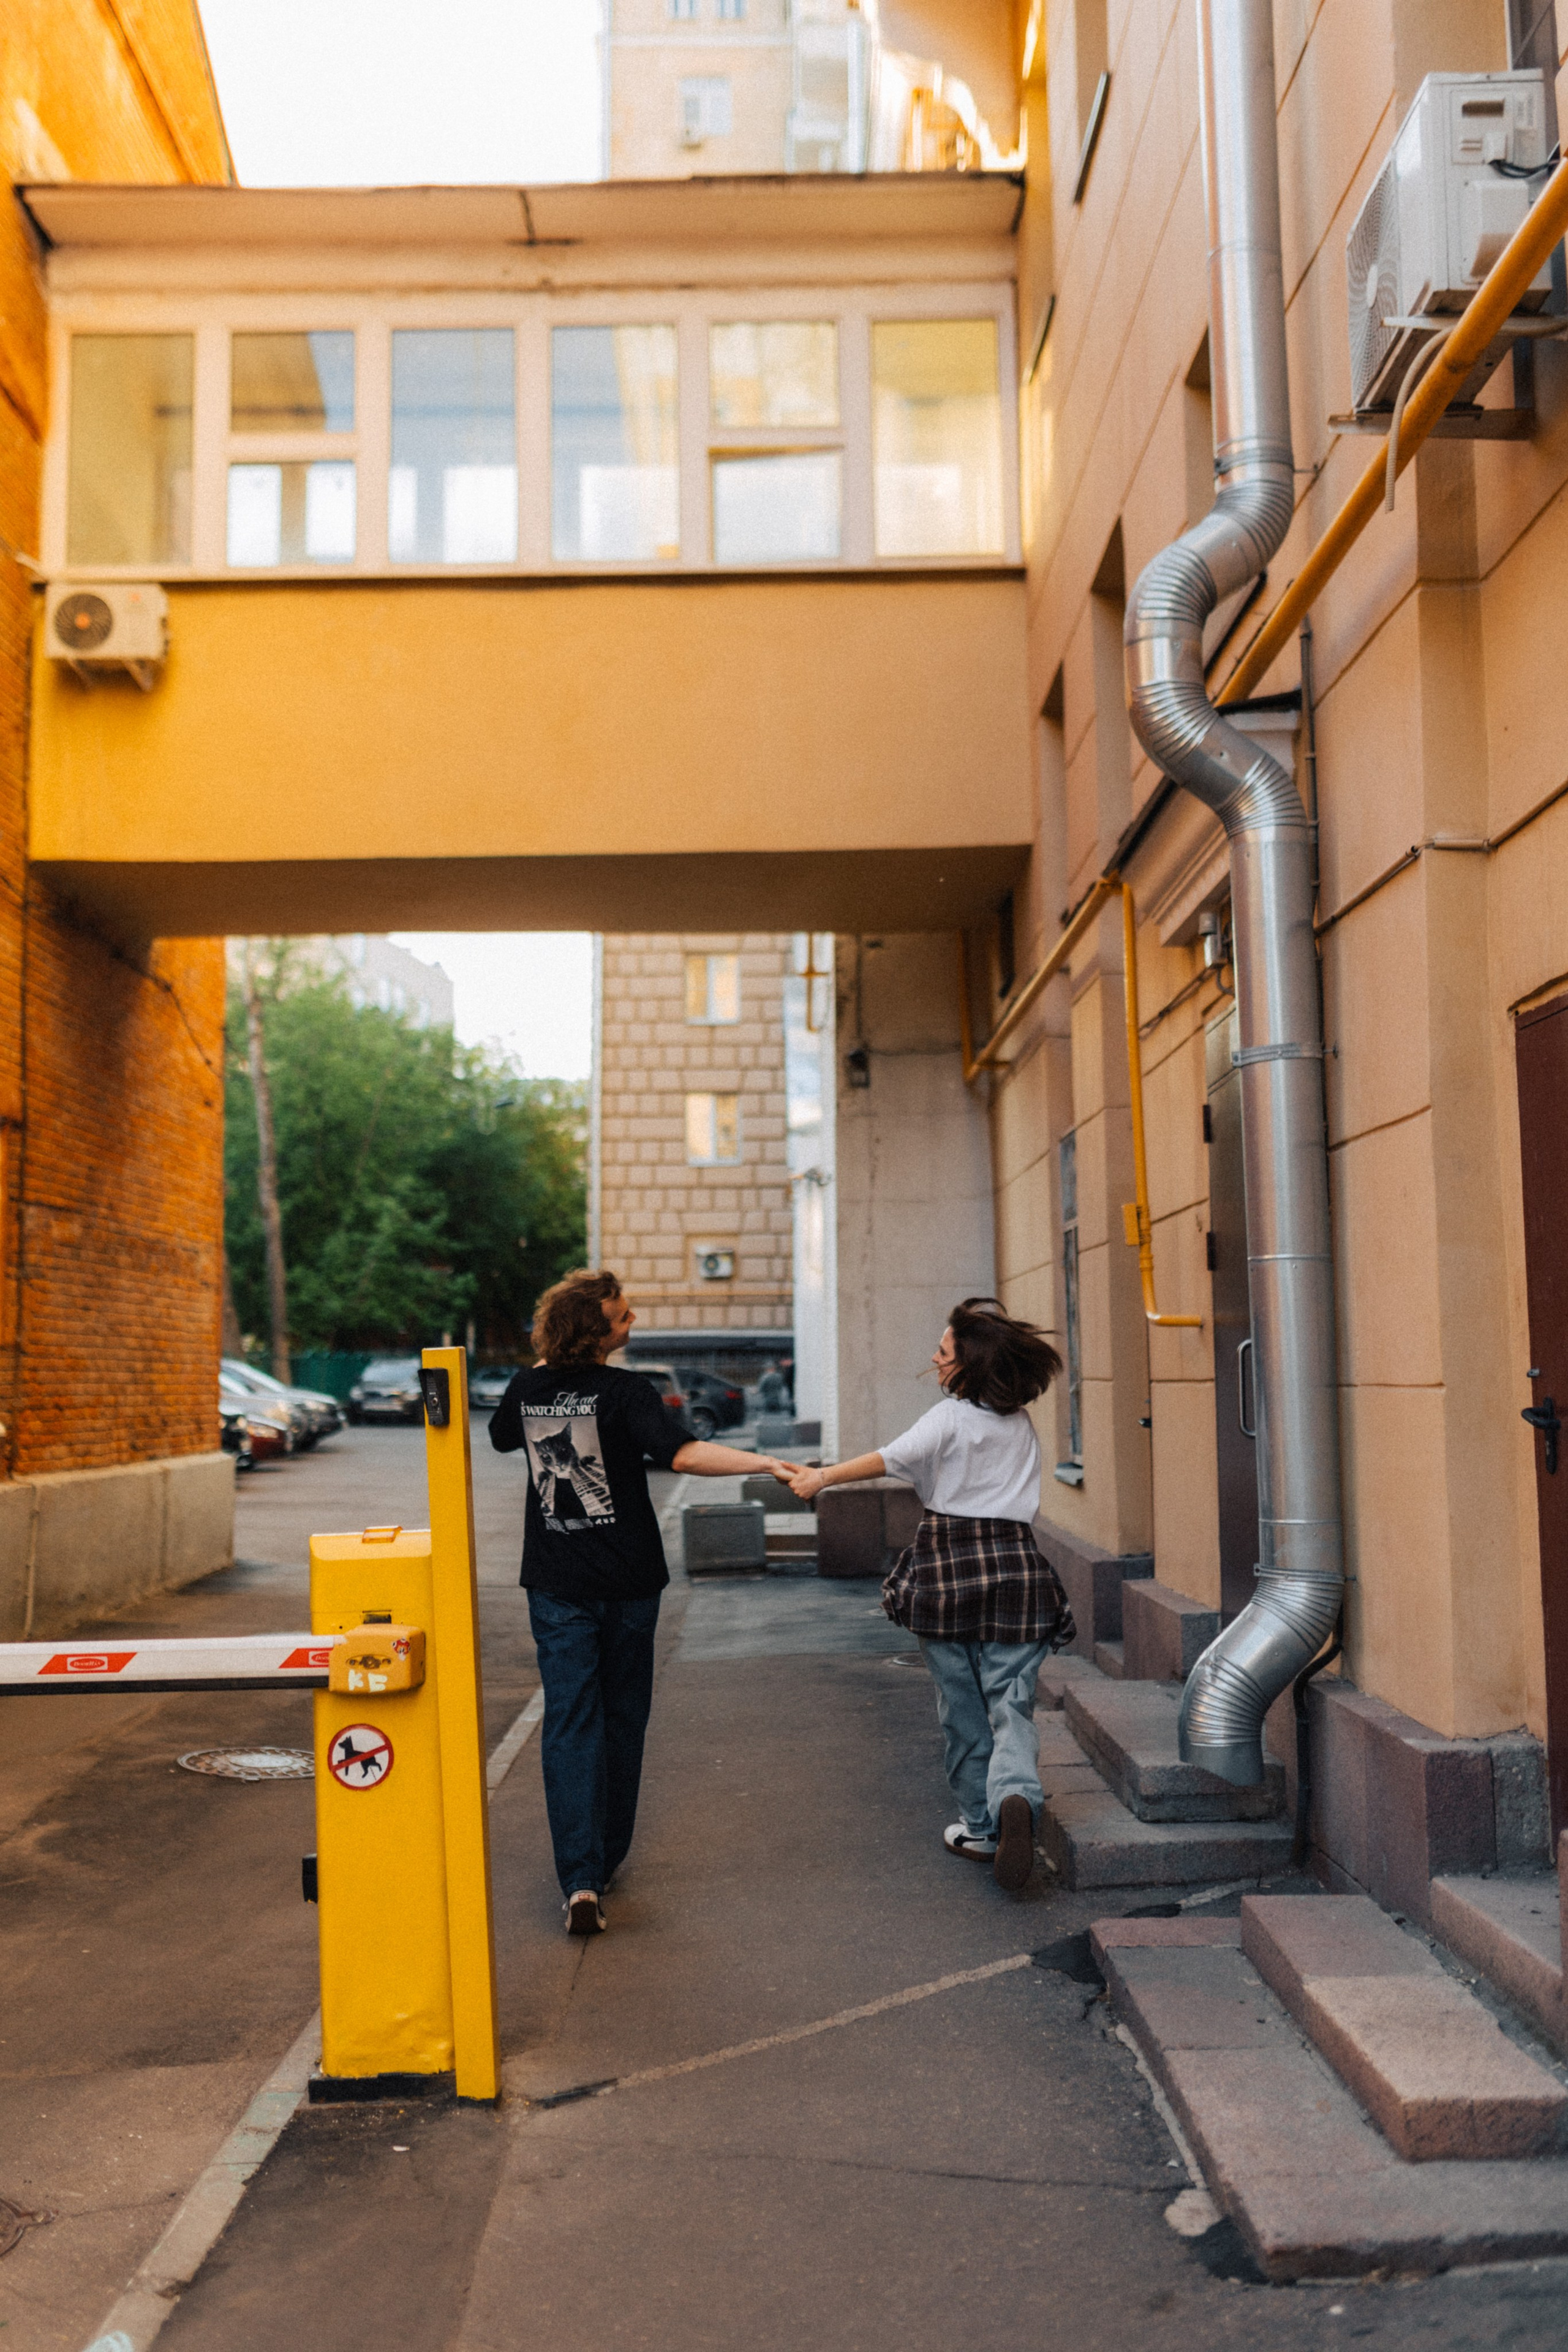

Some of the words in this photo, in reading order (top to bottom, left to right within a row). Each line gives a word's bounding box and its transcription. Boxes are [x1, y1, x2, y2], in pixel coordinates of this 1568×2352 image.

[554, 1392, 578, 1407] The
[579, 1394, 599, 1404] cat
[526, 1406, 576, 1416] WATCHING
[576, 1404, 597, 1415] YOU
